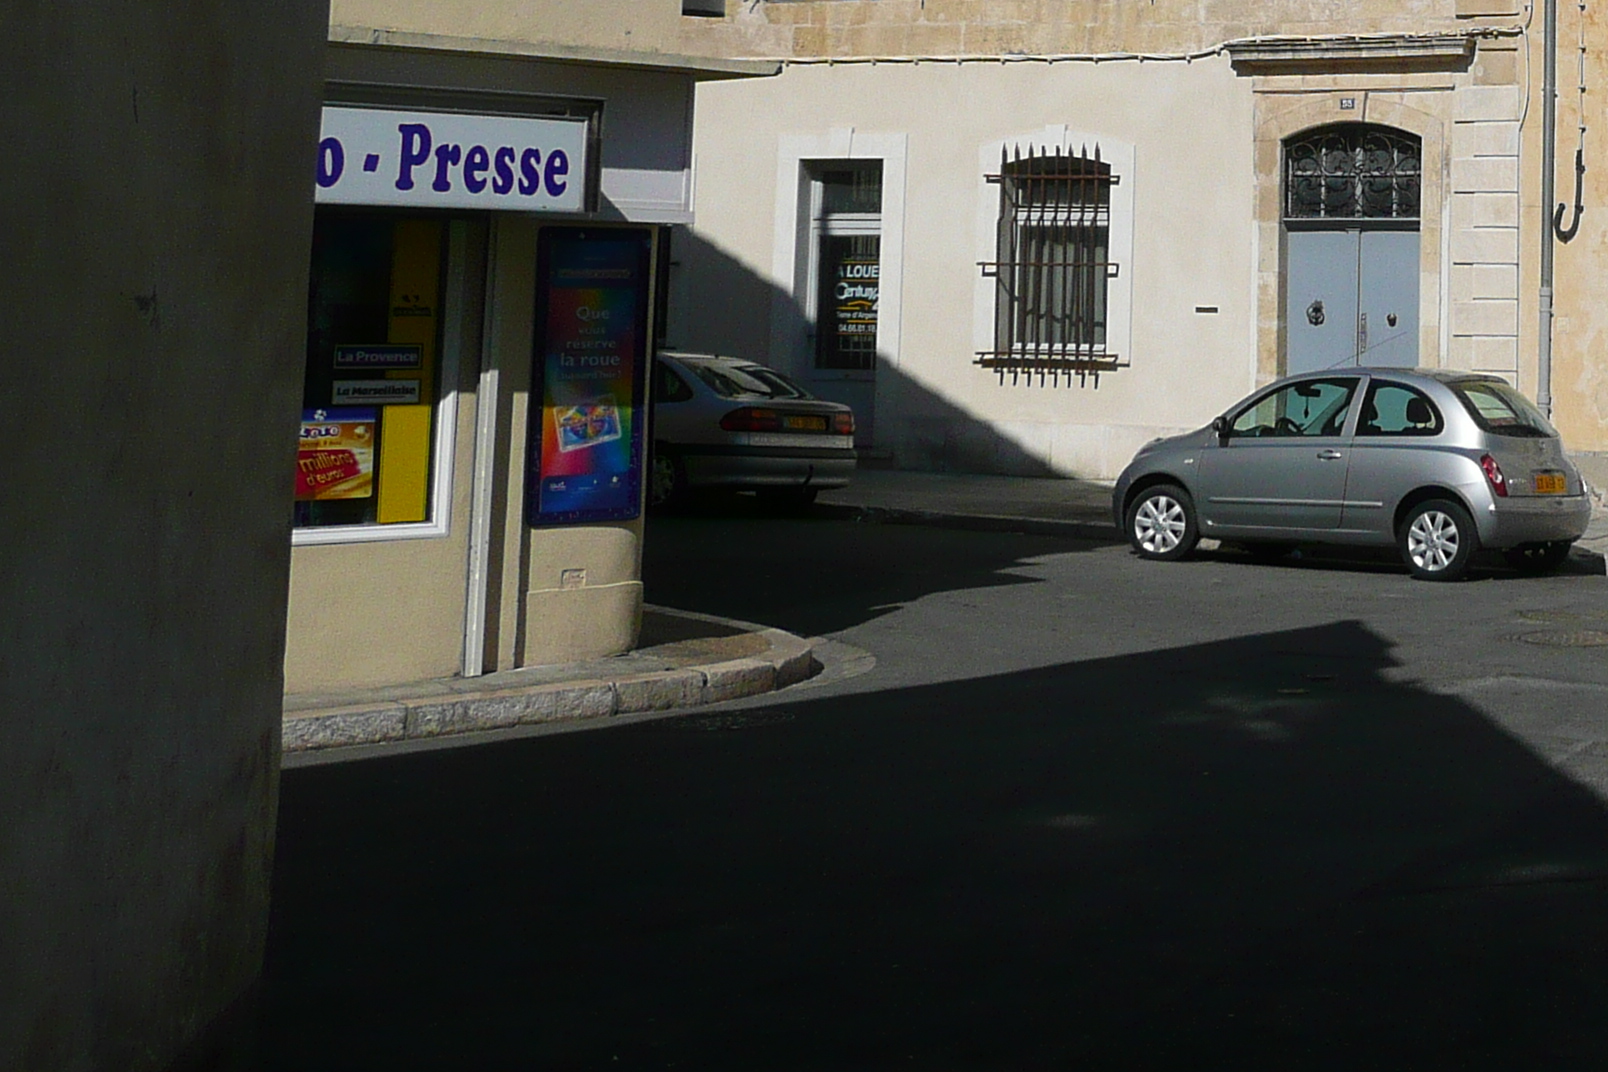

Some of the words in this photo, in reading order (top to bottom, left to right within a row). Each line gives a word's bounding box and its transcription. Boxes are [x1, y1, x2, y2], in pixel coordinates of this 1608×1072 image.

[395, 124, 570, 197] Presse
[576, 307, 610, 322] Que
[566, 338, 617, 349] réserve
[337, 351, 354, 362] La
[356, 351, 418, 362] Provence
[560, 352, 575, 367] la
[580, 355, 621, 367] roue
[299, 452, 353, 473] millions
